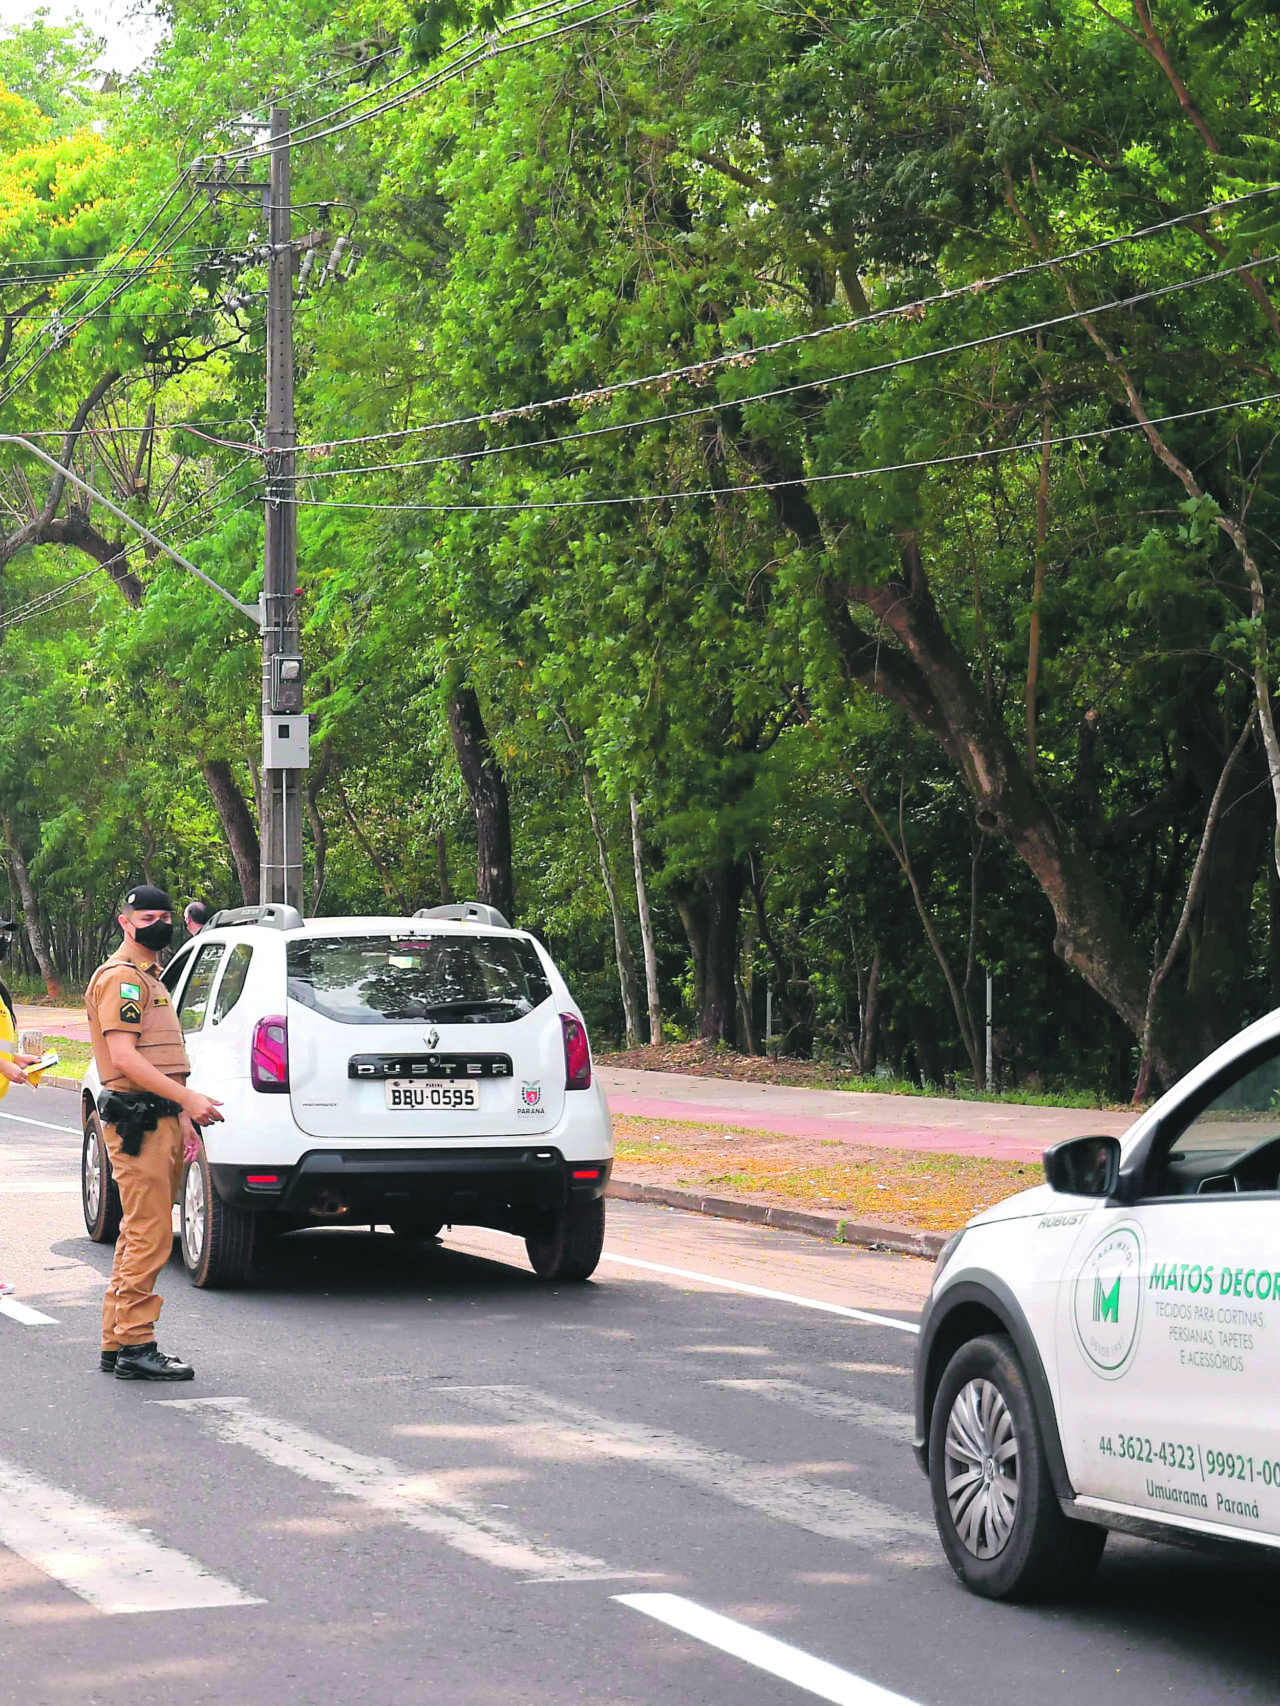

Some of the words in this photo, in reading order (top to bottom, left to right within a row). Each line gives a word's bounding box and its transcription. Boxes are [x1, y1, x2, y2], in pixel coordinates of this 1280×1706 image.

[357, 1063, 508, 1075] DUSTER
[1037, 1213, 1089, 1229] ROBUST
[1148, 1263, 1215, 1295] MATOS
[1155, 1302, 1192, 1320] TECIDOS
[1194, 1305, 1215, 1322] PARA
[1217, 1308, 1266, 1329] CORTINAS,
[1169, 1325, 1216, 1348] PERSIANAS,
[1218, 1331, 1254, 1350] TAPETES
[1180, 1349, 1186, 1364] E
[1188, 1349, 1244, 1372] ACESSÓRIOS
[1146, 1479, 1208, 1508] Umuarama
[1216, 1492, 1260, 1519] Paraná
